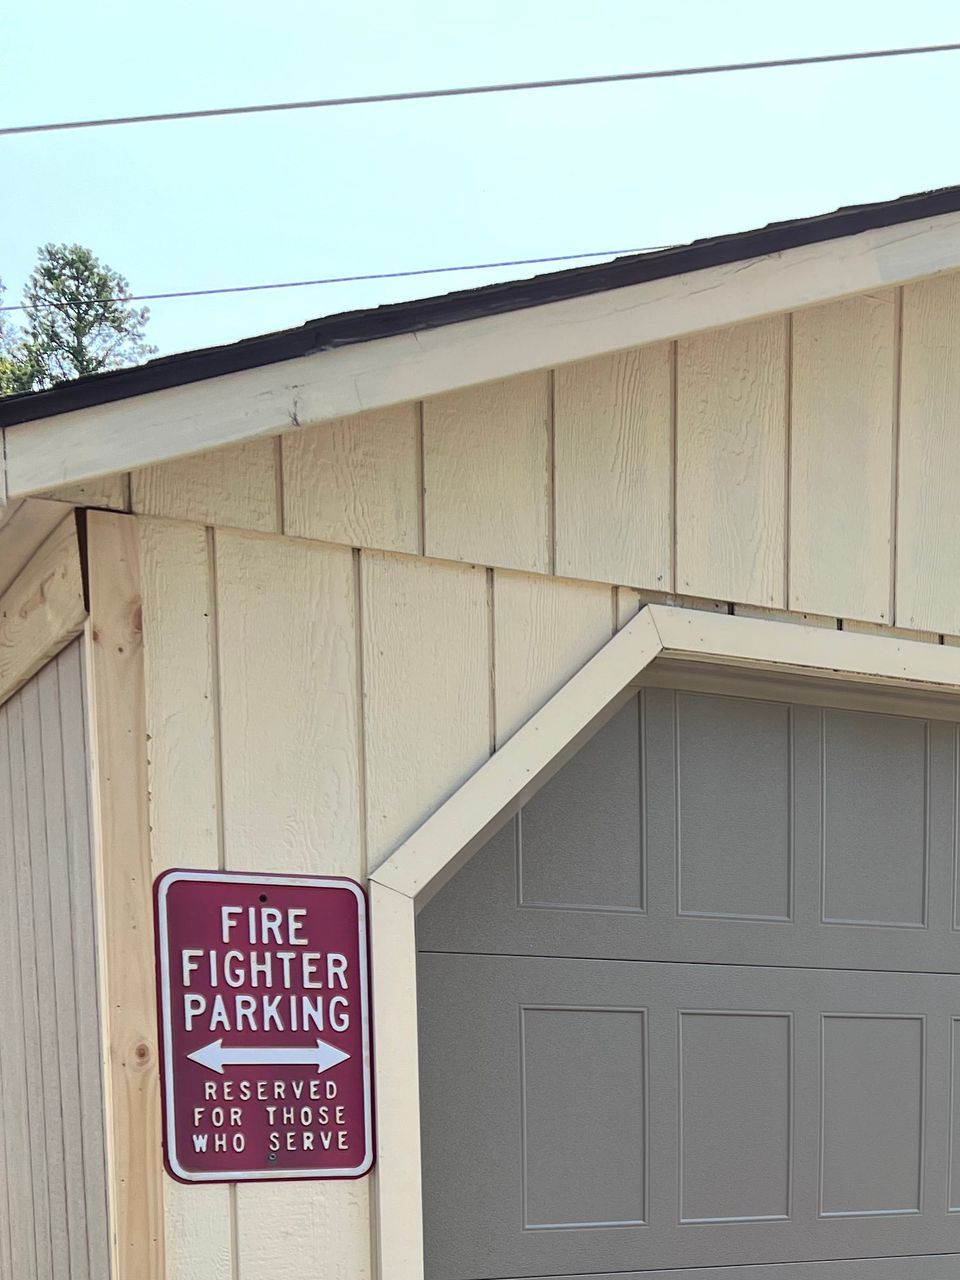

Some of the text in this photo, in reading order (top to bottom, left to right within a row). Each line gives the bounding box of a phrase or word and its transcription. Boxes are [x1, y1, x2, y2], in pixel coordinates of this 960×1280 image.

[221, 906, 308, 945] FIRE
[182, 950, 348, 989] FIGHTER
[183, 994, 350, 1032] PARKING
[204, 1081, 337, 1101] RESERVED
[193, 1106, 346, 1127] FOR THOSE
[192, 1131, 349, 1153] WHO SERVE
